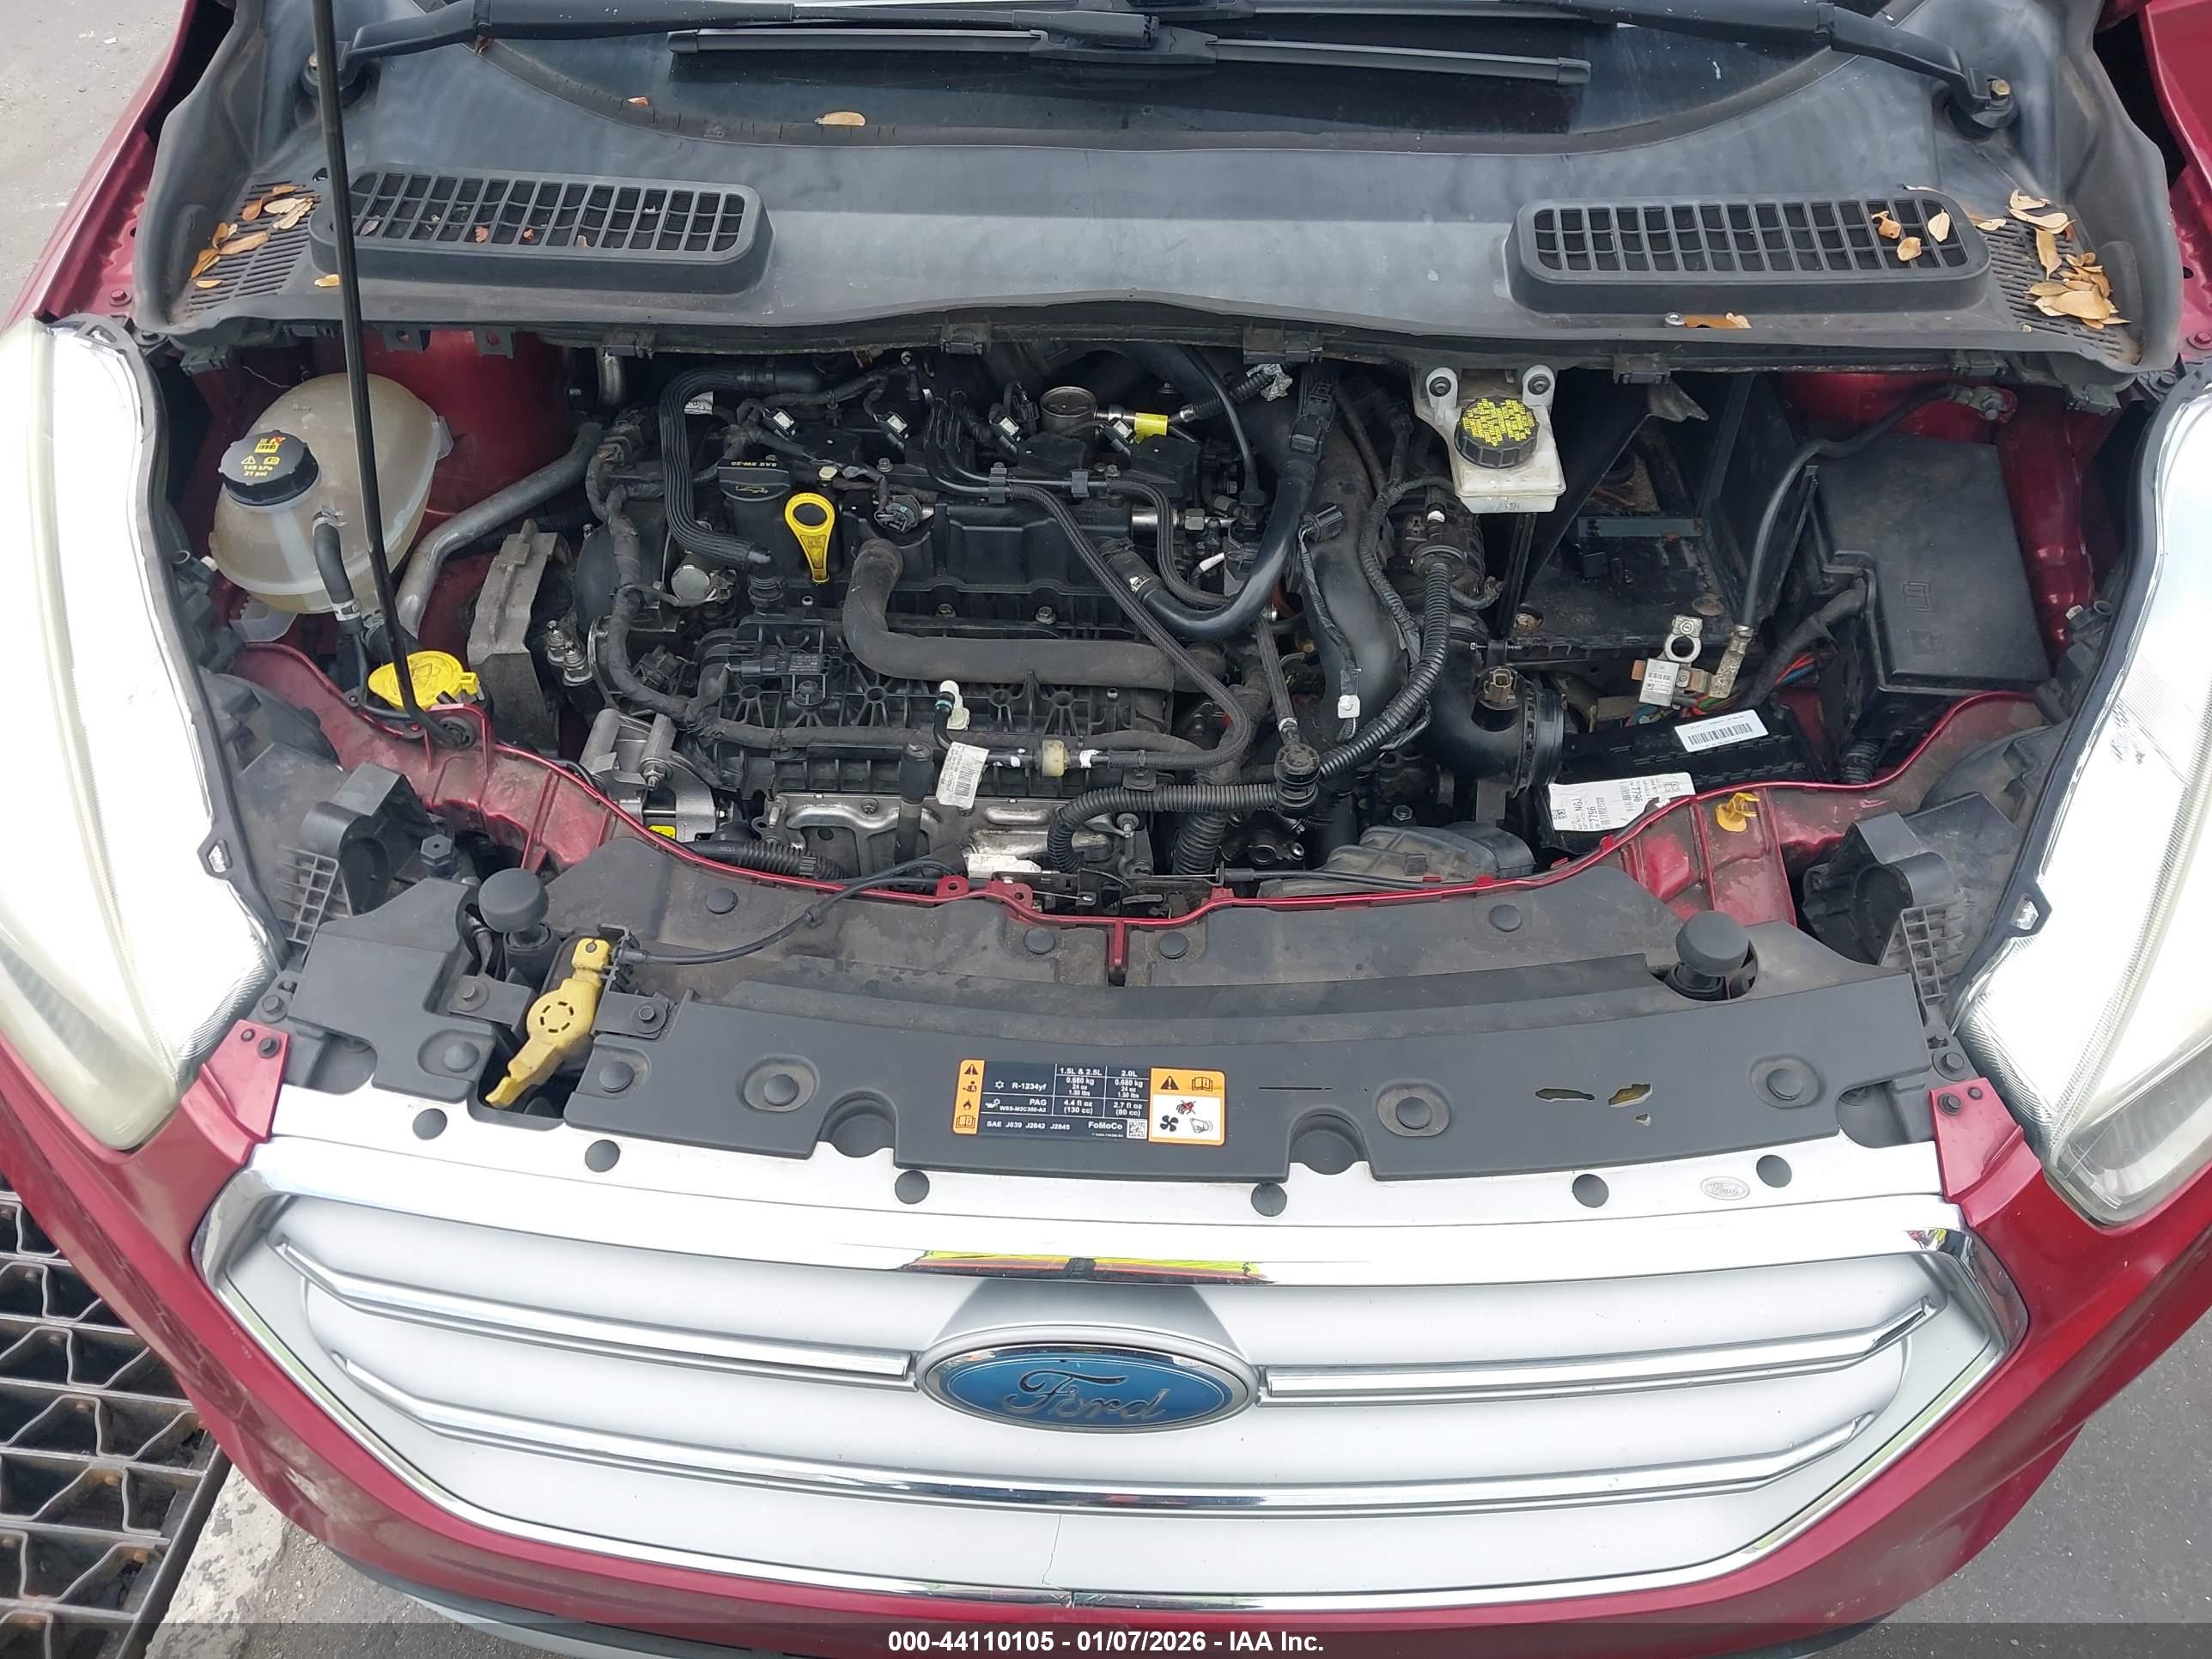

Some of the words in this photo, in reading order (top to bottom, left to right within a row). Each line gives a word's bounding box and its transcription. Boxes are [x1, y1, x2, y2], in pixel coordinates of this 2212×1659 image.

[1012, 1082, 1047, 1091] R-1234yf
[1085, 1078, 1095, 1086] kg
[1088, 1121, 1123, 1130] FoMoCo
[1002, 1370, 1170, 1419] Ford
